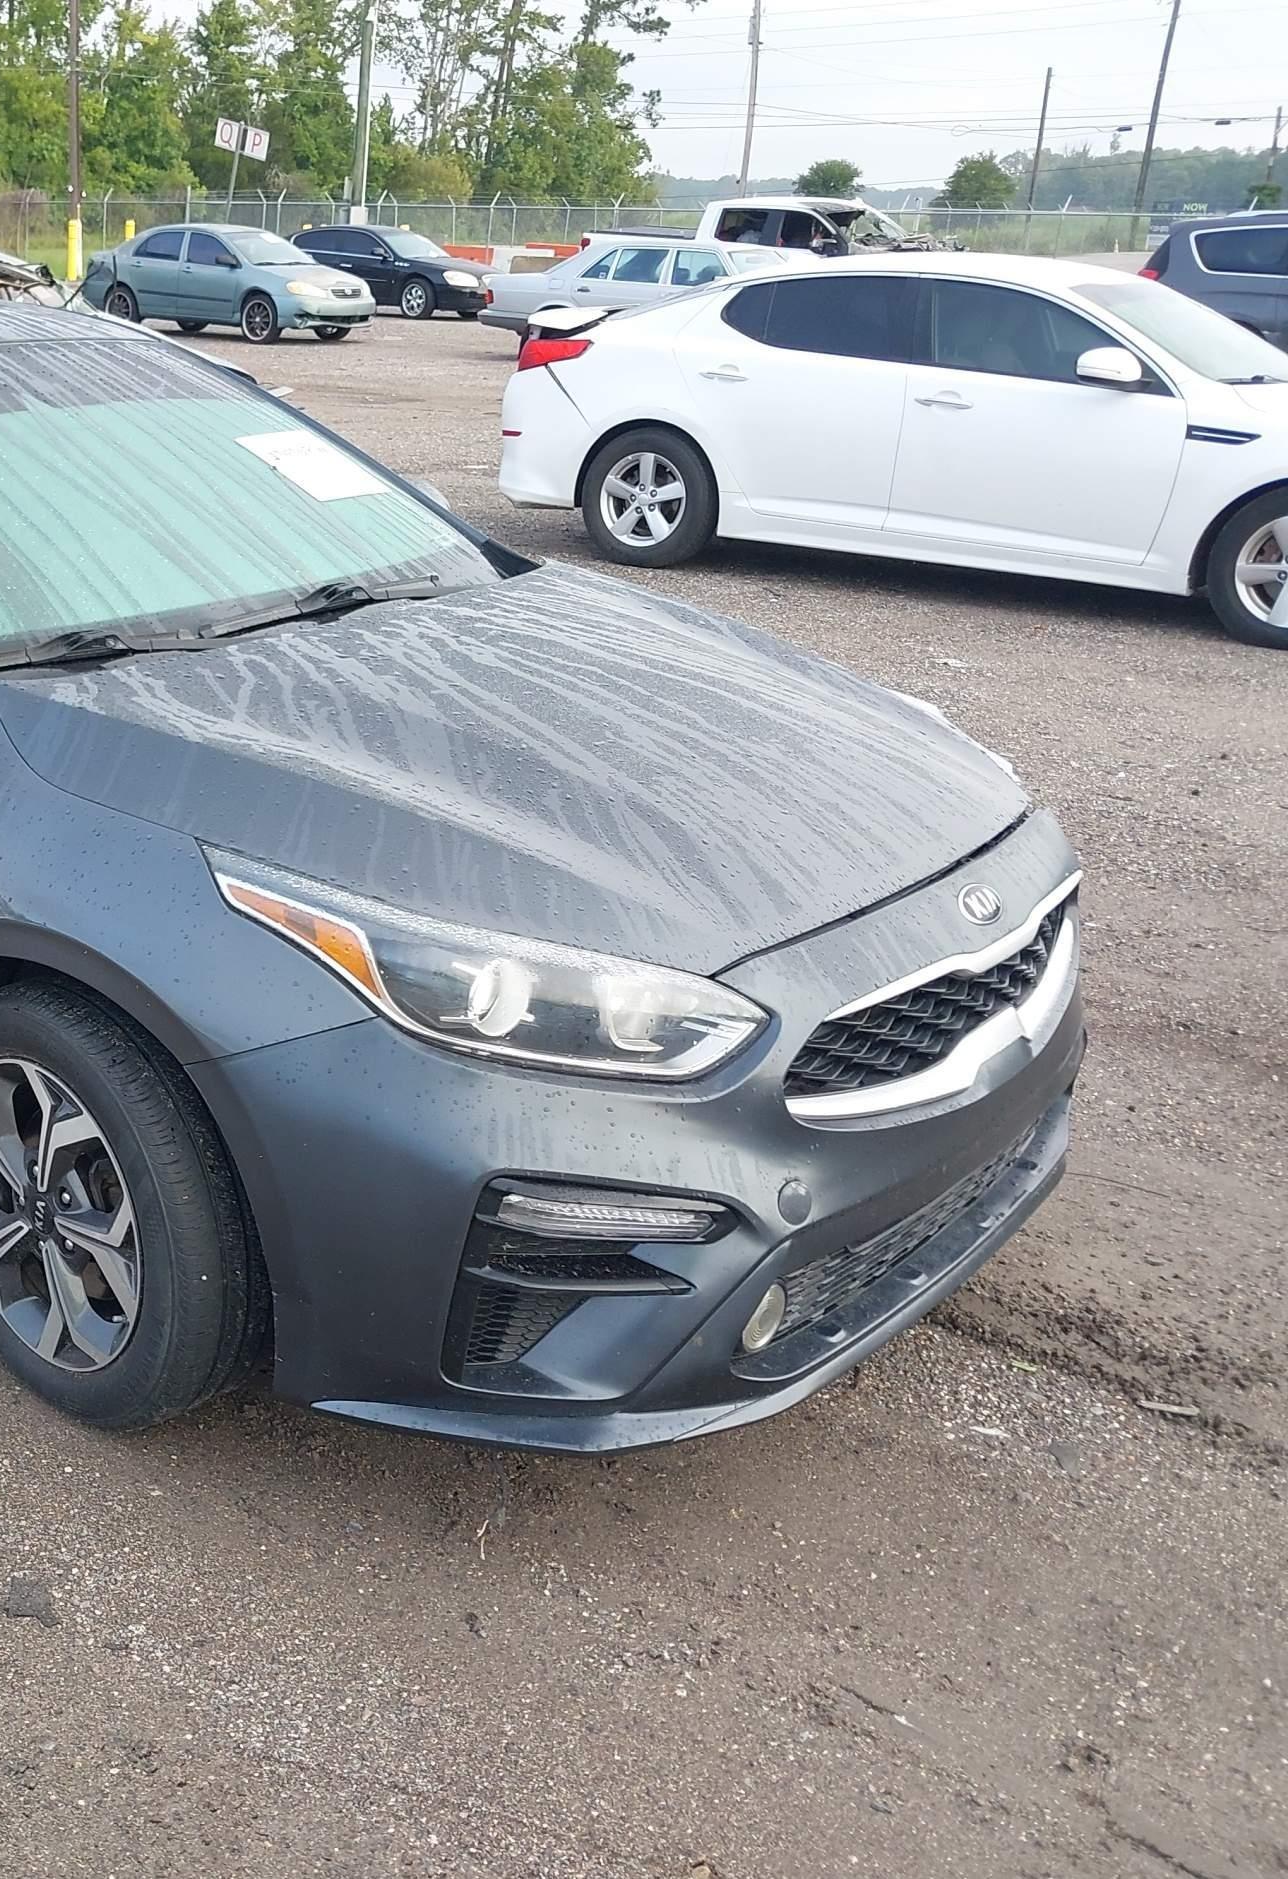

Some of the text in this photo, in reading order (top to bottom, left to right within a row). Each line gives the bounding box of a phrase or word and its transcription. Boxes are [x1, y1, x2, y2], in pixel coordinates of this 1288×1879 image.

[220, 122, 232, 148] Q
[251, 133, 262, 152] P
[1183, 202, 1208, 212] NOW
[964, 887, 999, 919] KIA
[34, 1200, 46, 1231] KIA
